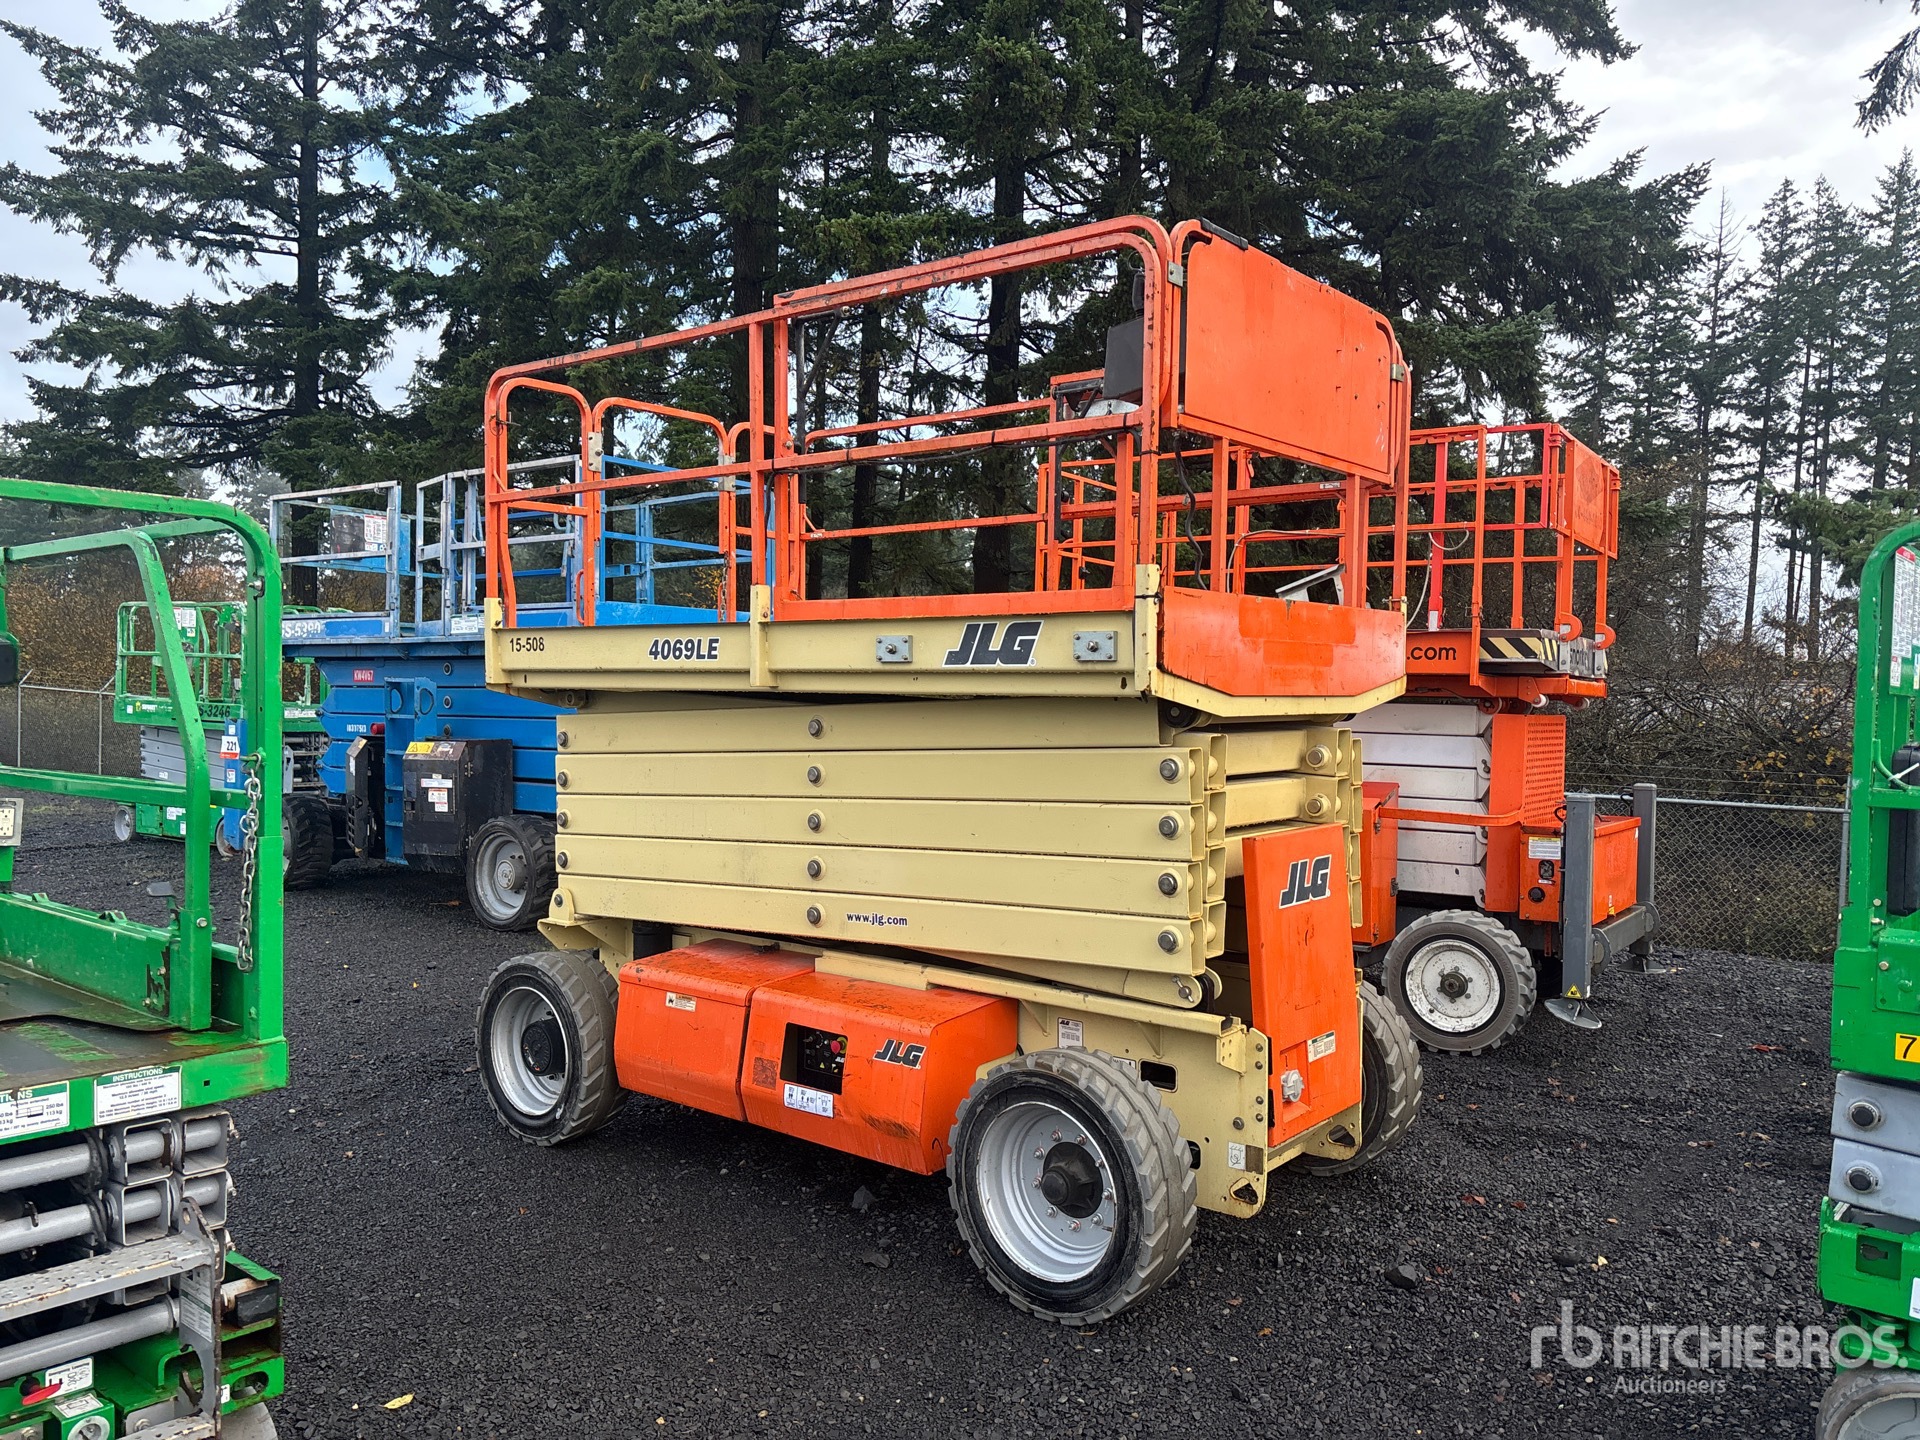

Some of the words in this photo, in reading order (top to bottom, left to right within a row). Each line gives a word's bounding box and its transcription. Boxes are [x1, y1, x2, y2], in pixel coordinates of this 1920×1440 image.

[509, 637, 545, 652] 15-508
[648, 637, 720, 661] 4069LE
[942, 620, 1044, 667] JLG
[226, 740, 237, 751] 221
[1279, 854, 1332, 909] JLG
[846, 912, 908, 926] www.jlg.com
[873, 1039, 926, 1069] JLG
[1900, 1035, 1917, 1059] 7
[113, 1067, 164, 1083] INSTRUCTIONS
